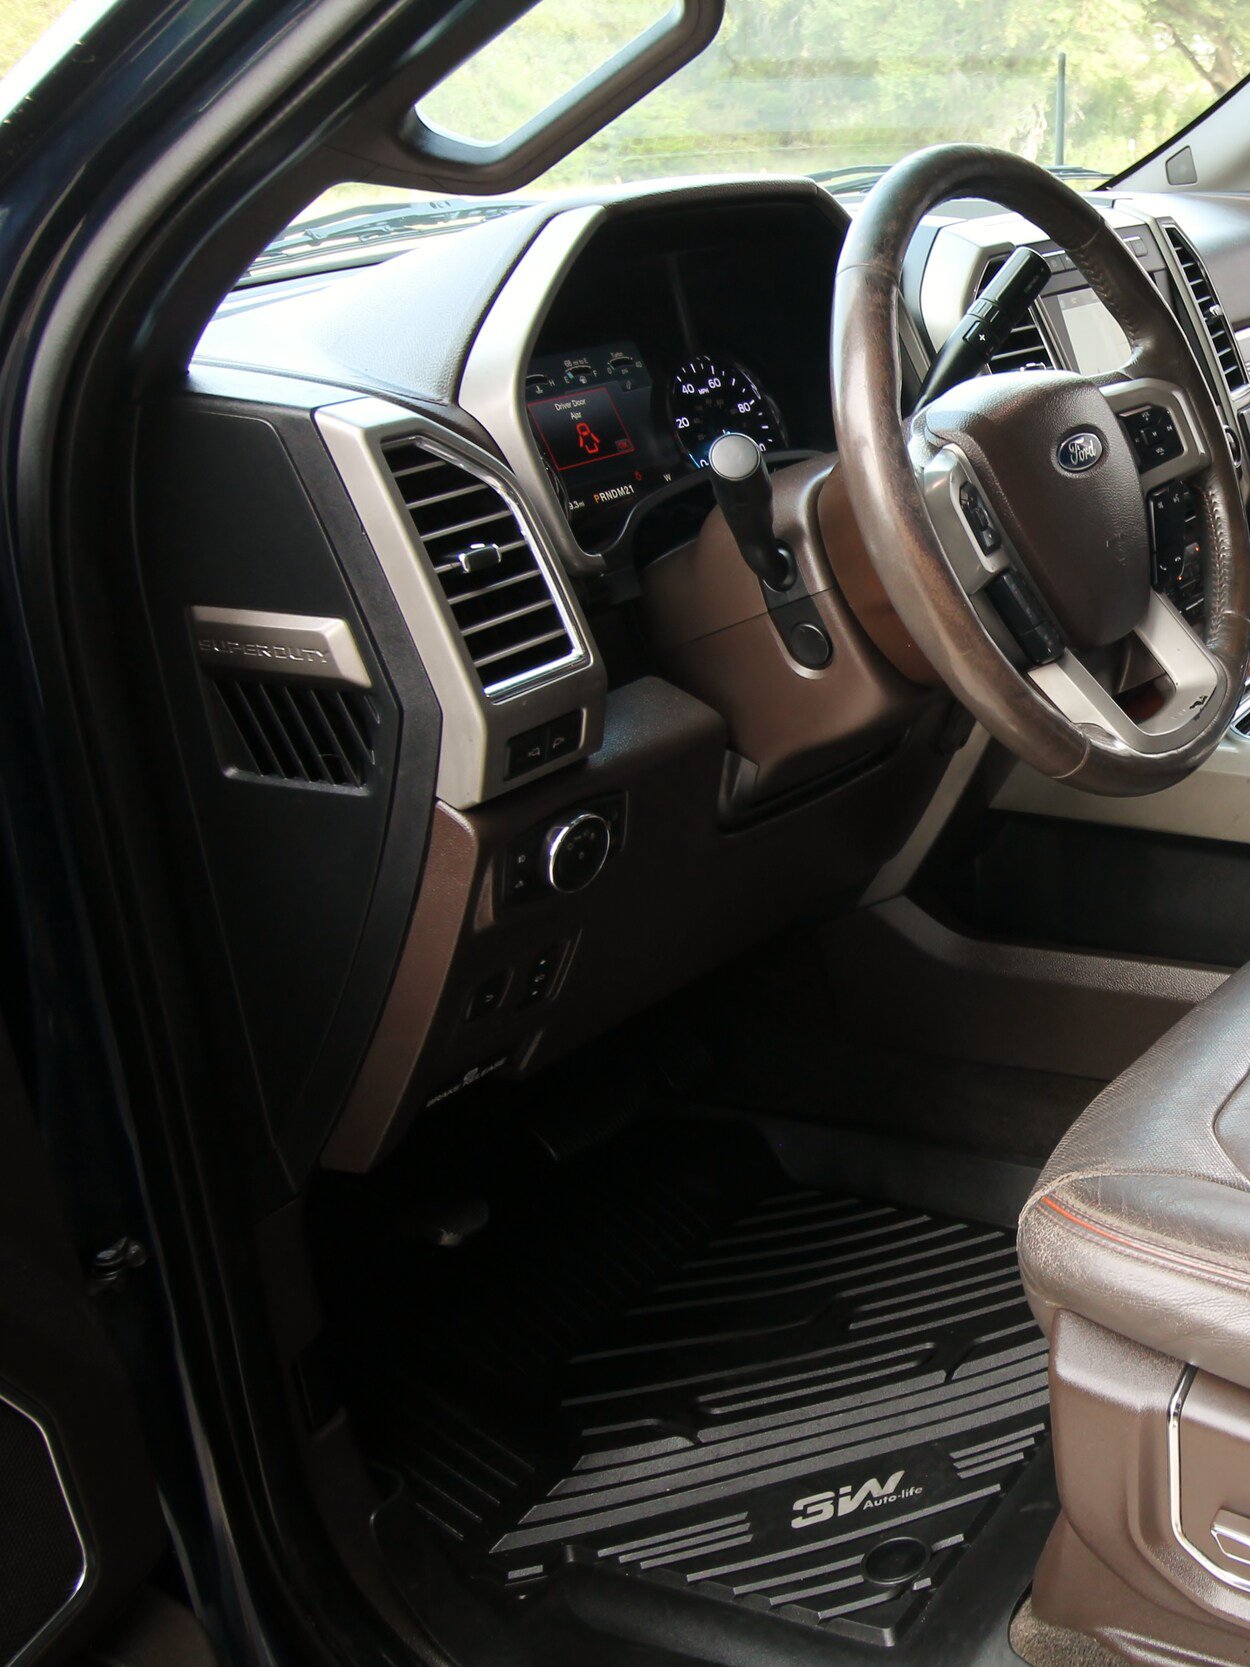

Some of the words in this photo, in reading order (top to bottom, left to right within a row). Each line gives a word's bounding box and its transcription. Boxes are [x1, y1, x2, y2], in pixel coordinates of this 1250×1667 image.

[681, 383, 695, 395] 40
[707, 377, 722, 389] 60
[554, 401, 572, 412] Driver
[571, 398, 587, 408] Door
[737, 401, 752, 414] 80
[570, 411, 582, 420] Ajar
[675, 416, 690, 429] 20
[1068, 436, 1096, 465] Ford
[198, 639, 272, 659] SUPER
[273, 644, 329, 664] DUTY
[862, 1485, 924, 1511] Auto-life
